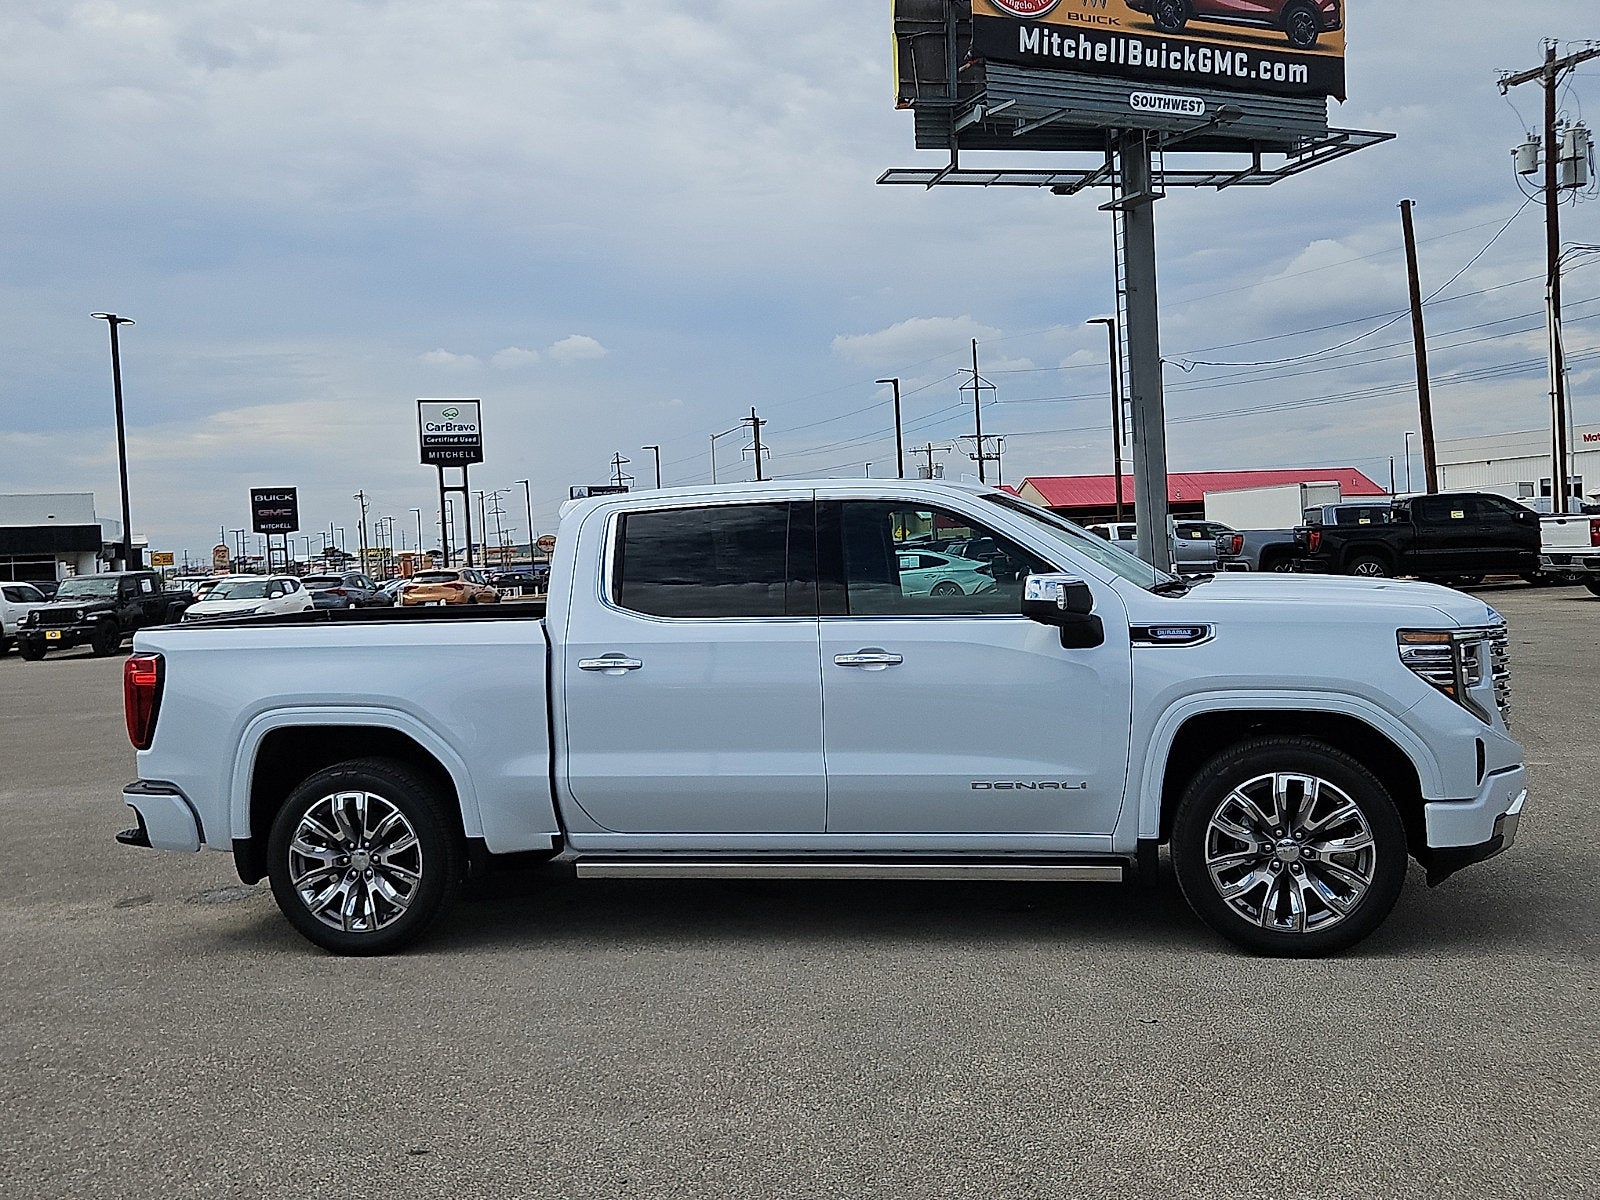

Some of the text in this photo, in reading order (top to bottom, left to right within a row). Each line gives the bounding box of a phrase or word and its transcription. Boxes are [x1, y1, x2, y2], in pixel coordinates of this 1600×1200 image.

[1067, 12, 1121, 25] BUICK
[1019, 26, 1308, 83] MitchellBuickGMC.com
[1132, 94, 1204, 113] SOUTHWEST
[425, 422, 476, 432] CarBravo
[428, 451, 477, 459] MITCHELL
[971, 780, 1087, 789] DENALI
